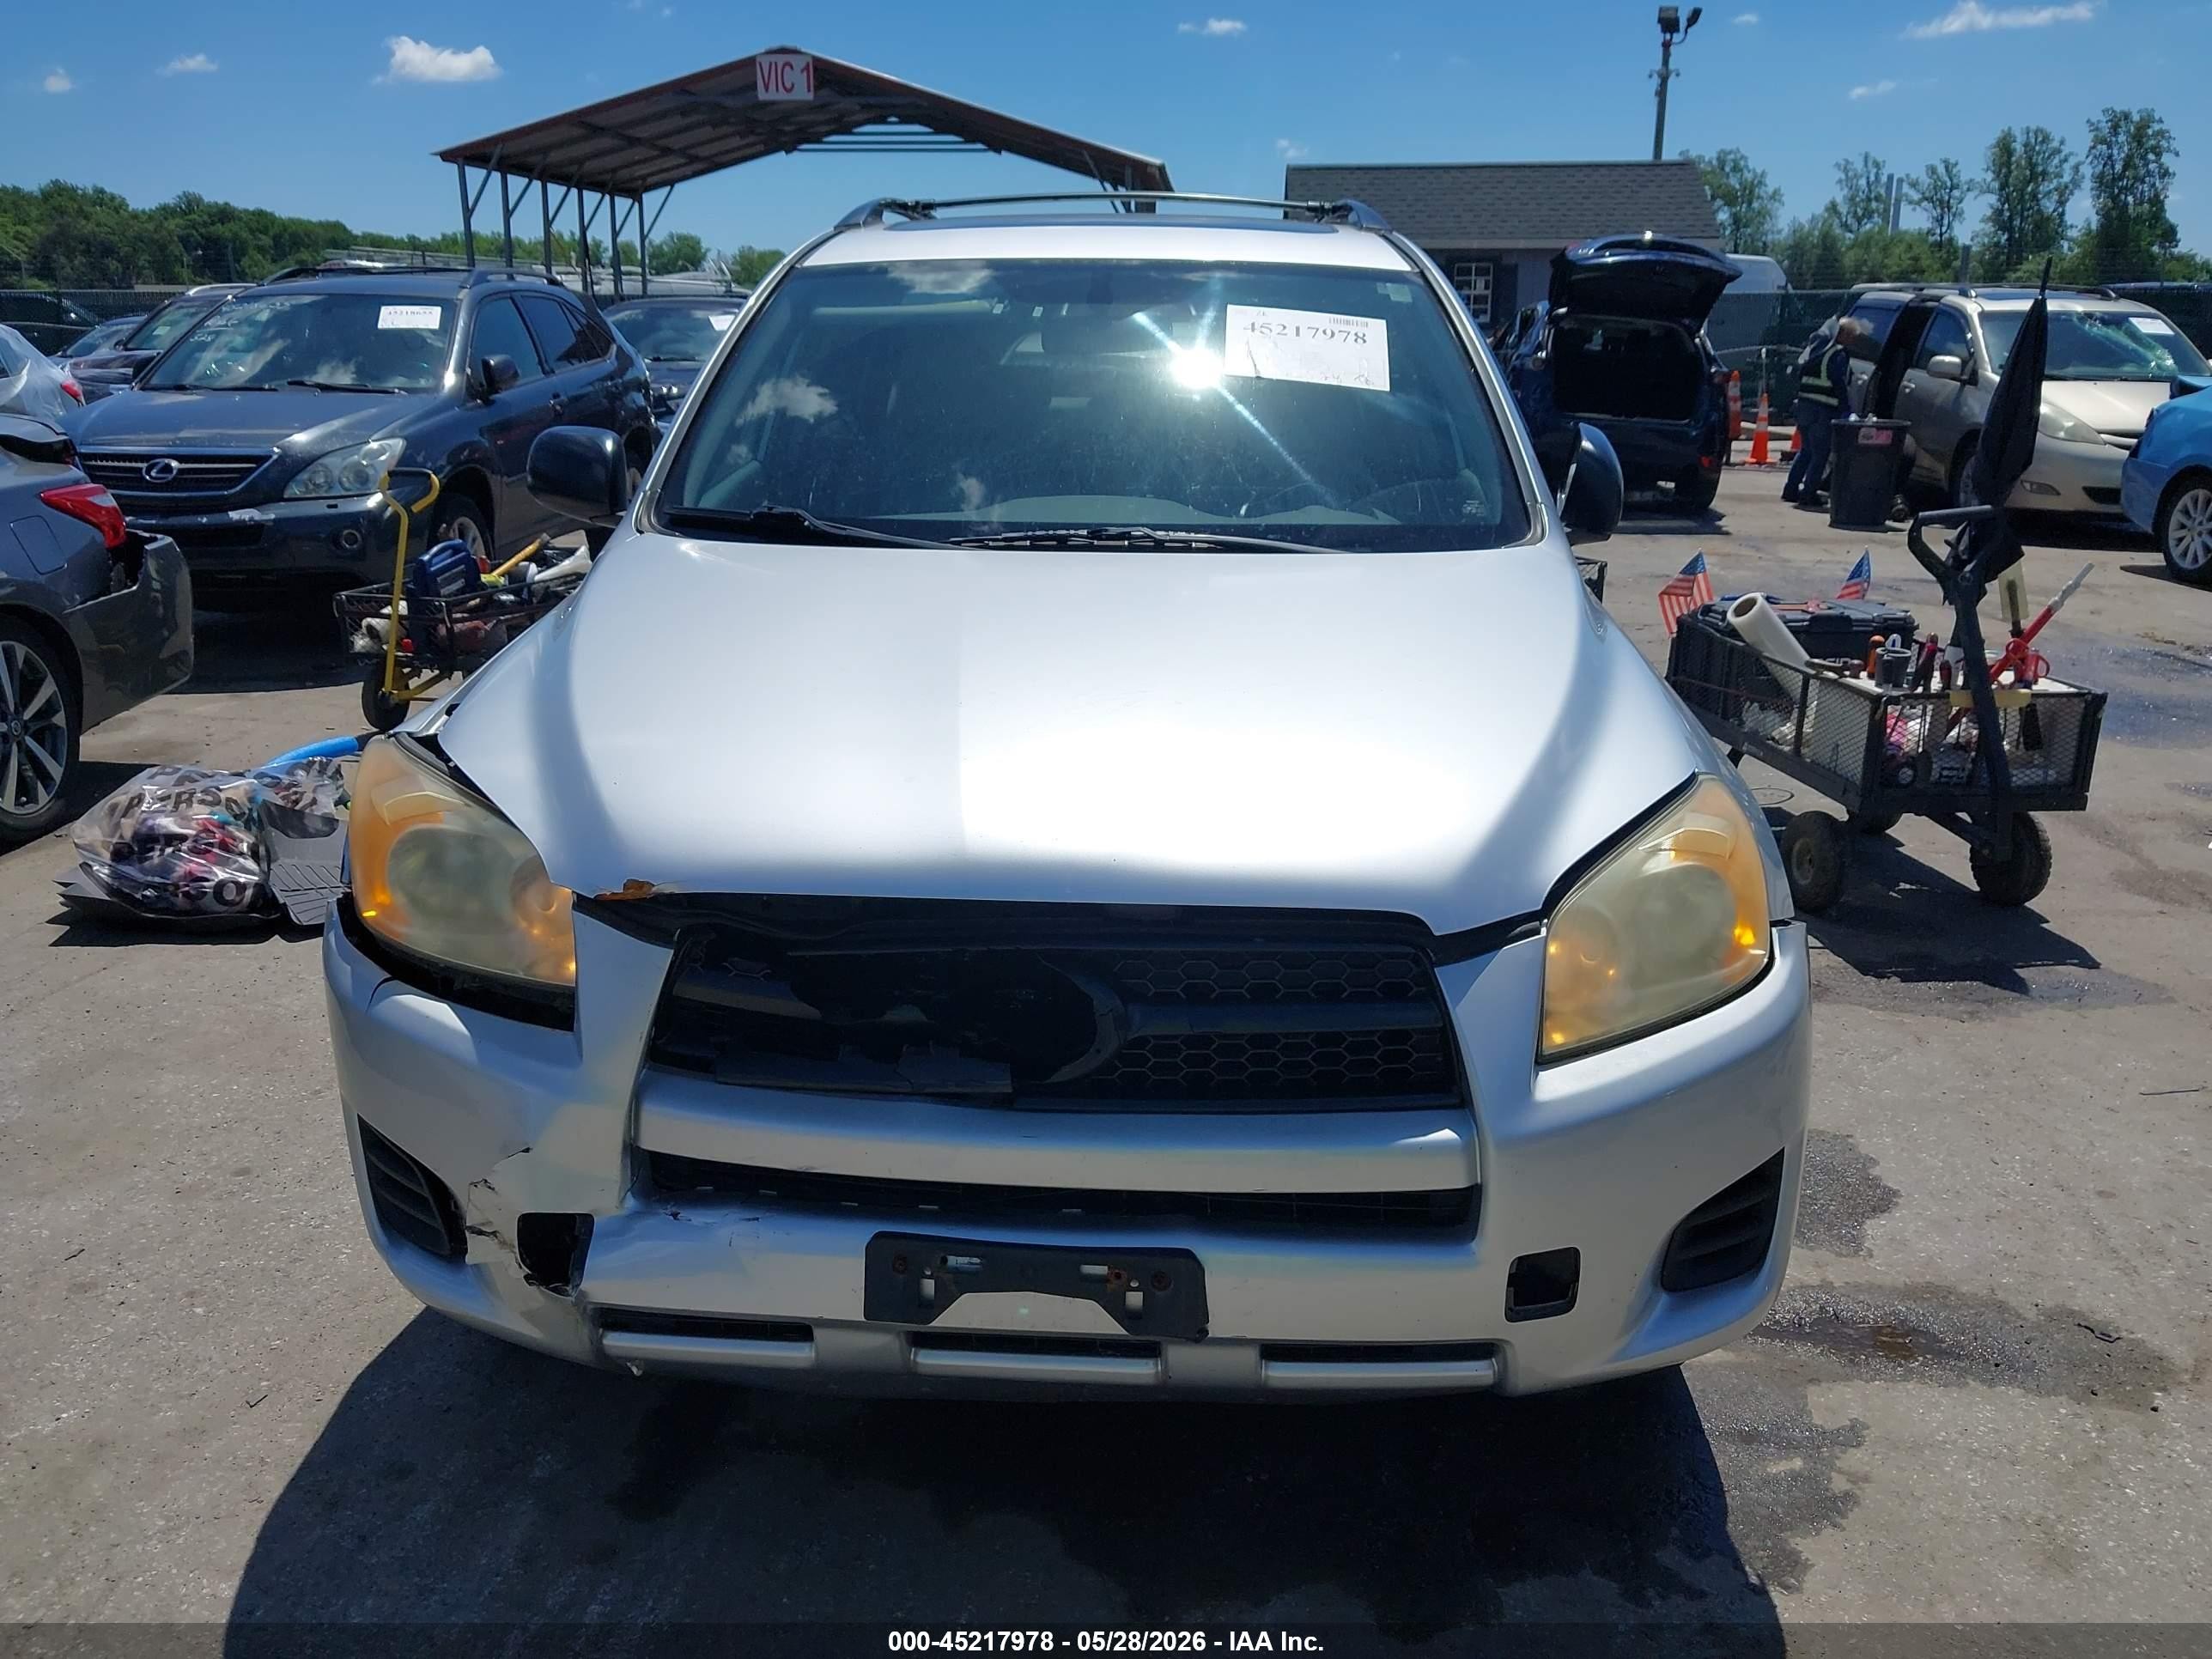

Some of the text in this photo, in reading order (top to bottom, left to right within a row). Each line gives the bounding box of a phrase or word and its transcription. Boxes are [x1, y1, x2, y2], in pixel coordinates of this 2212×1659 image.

[758, 61, 811, 94] VIC 1
[1243, 320, 1368, 344] 45217978
